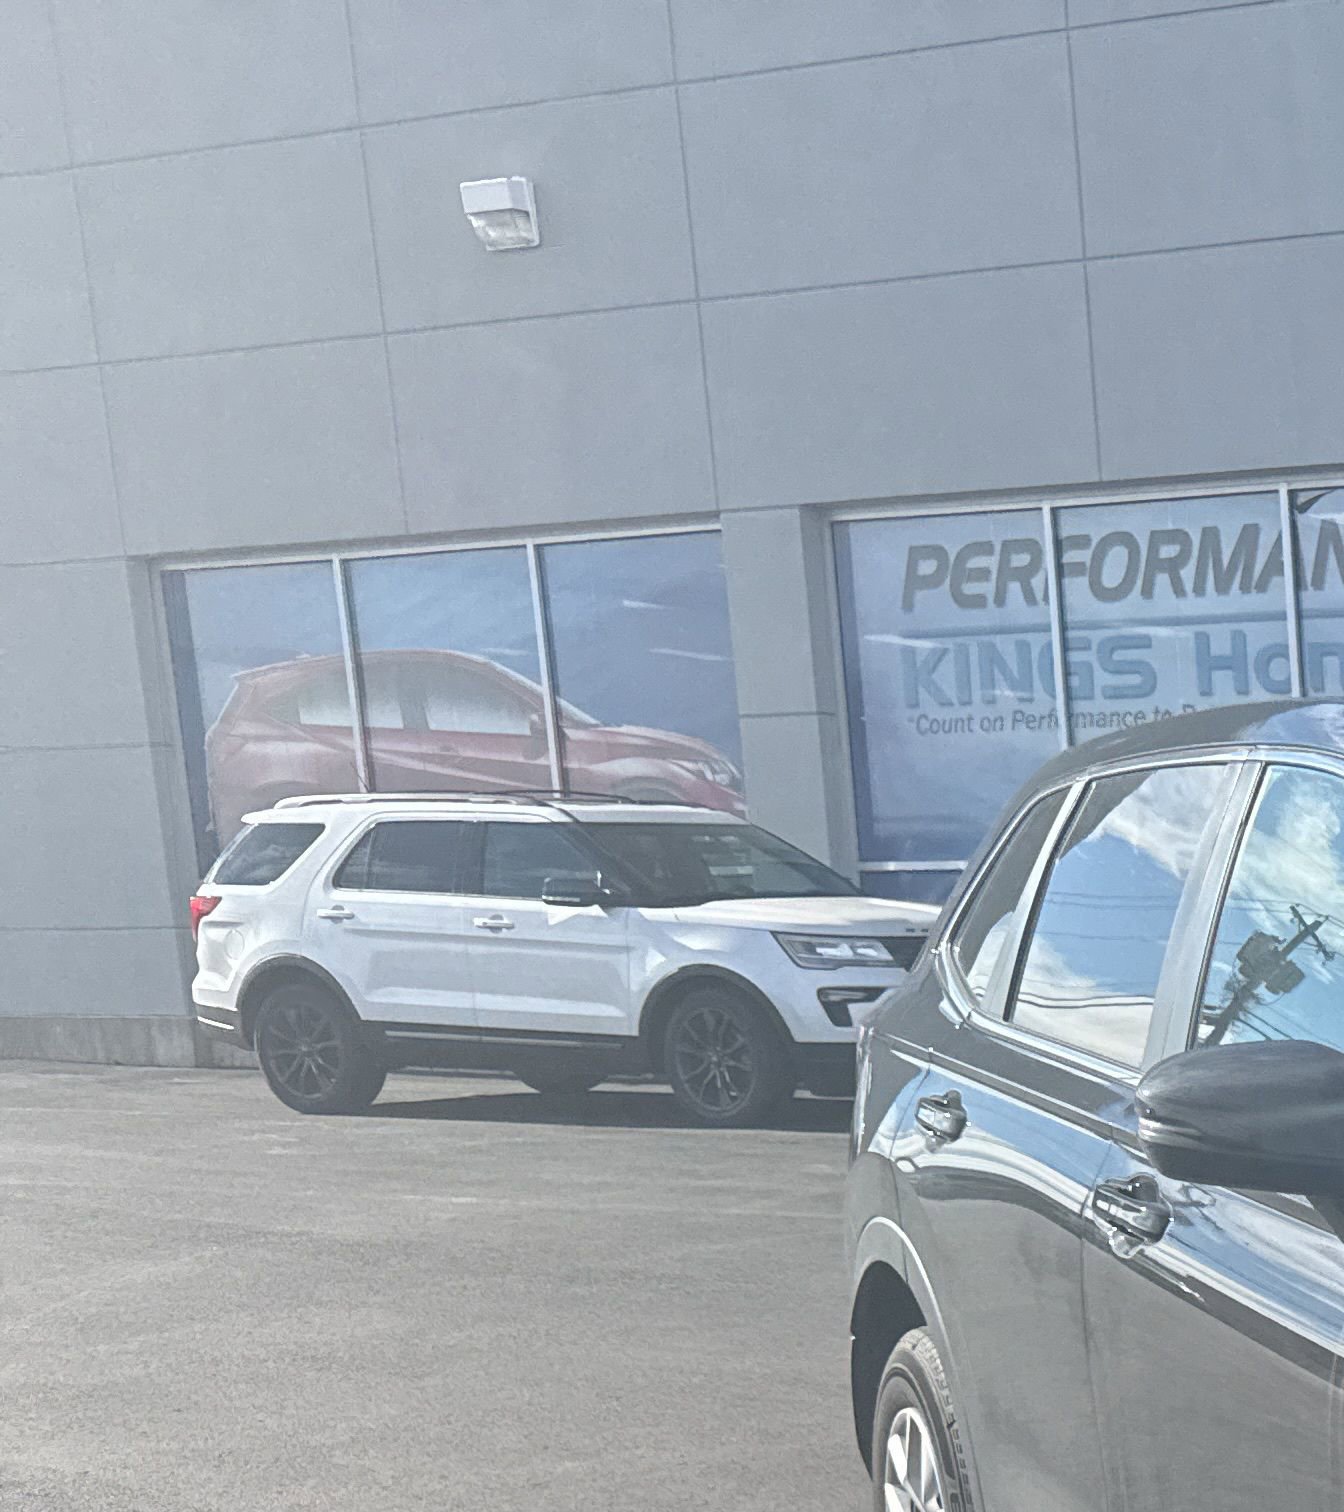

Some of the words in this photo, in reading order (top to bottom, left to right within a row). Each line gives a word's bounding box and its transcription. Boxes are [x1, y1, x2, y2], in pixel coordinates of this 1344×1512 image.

[904, 634, 1157, 709] KINGS
[980, 715, 1004, 733] on
[1011, 708, 1146, 731] Perfmance
